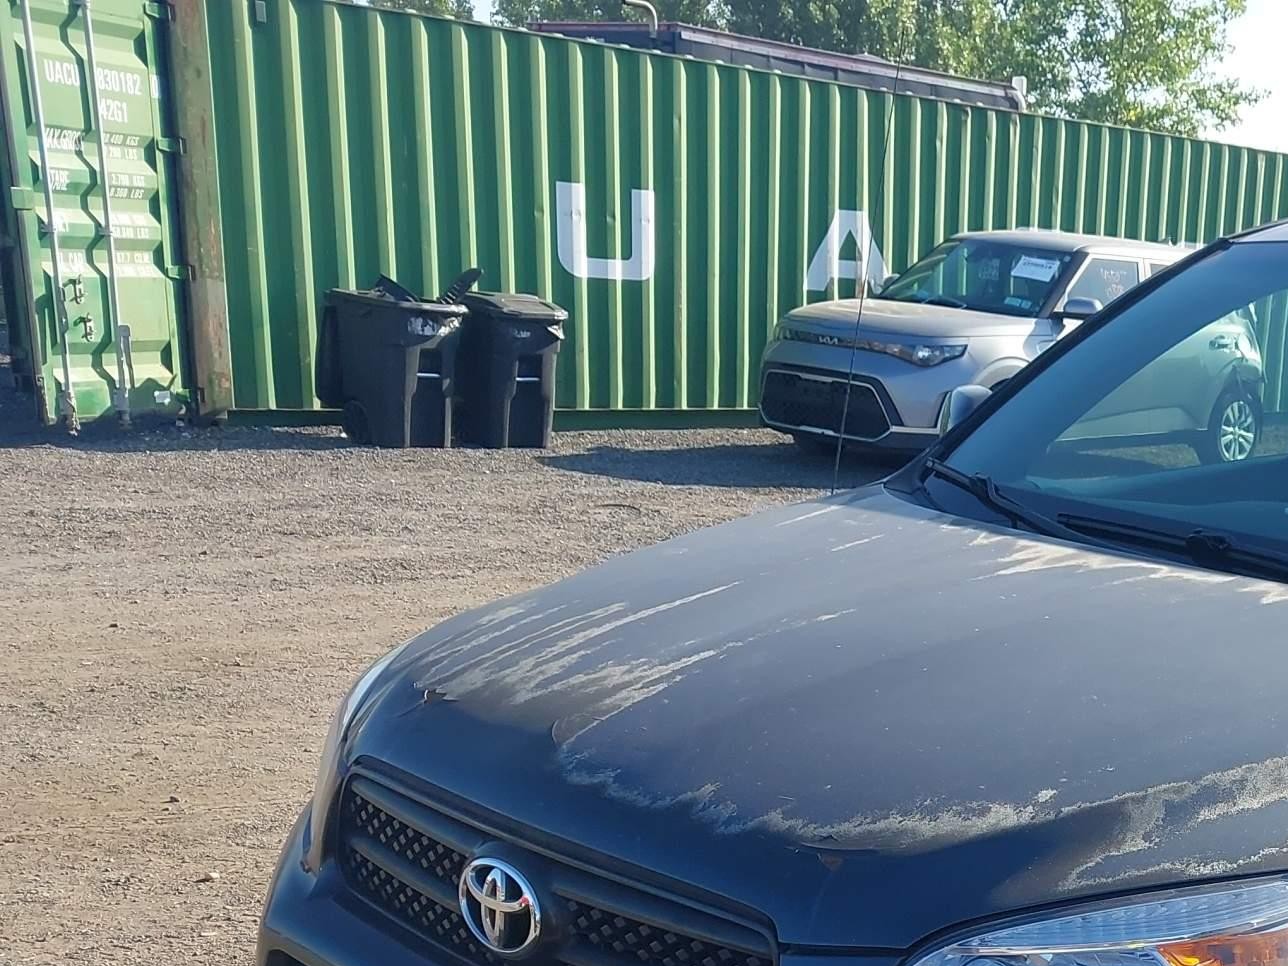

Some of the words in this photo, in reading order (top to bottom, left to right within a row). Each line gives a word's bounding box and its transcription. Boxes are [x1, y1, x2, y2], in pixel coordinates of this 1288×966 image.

[44, 59, 80, 86] UACU
[96, 67, 142, 95] 830182
[100, 97, 128, 123] 42G1
[555, 181, 655, 281] U
[805, 209, 890, 294] A
